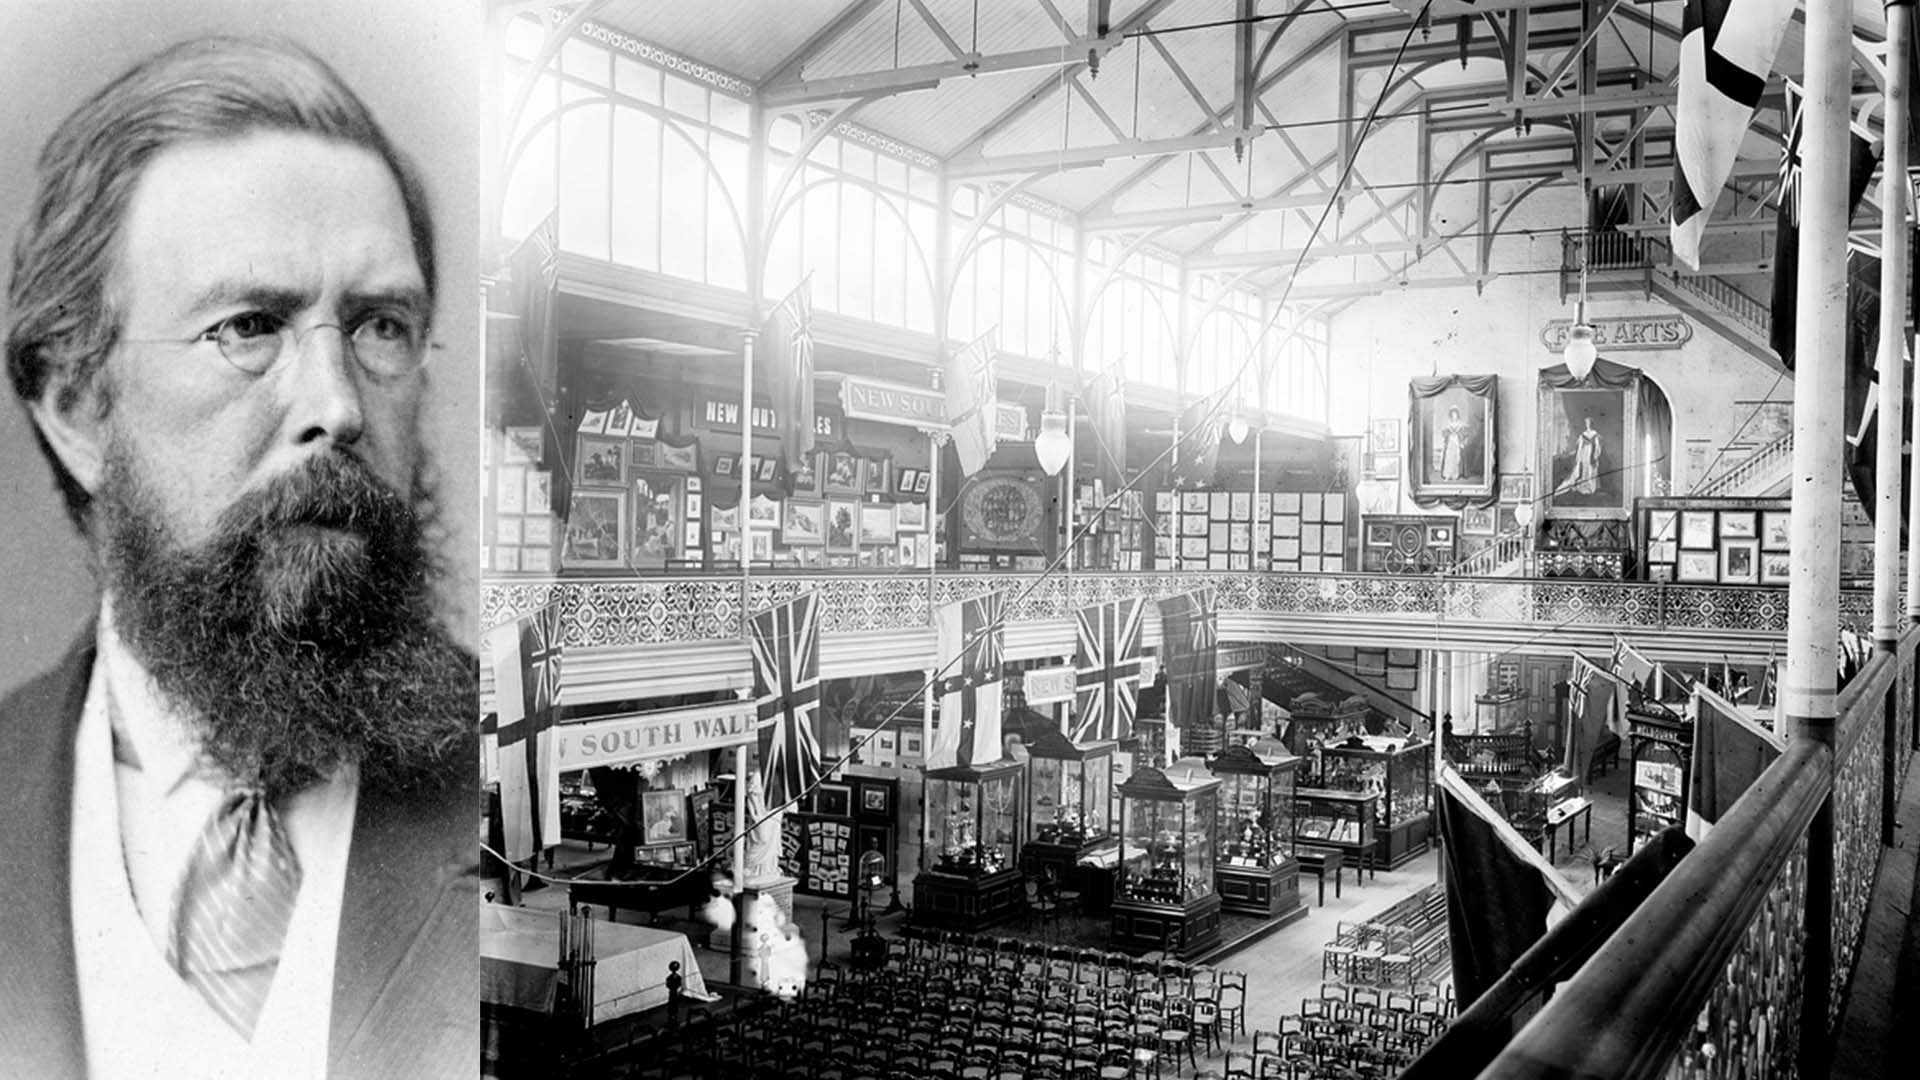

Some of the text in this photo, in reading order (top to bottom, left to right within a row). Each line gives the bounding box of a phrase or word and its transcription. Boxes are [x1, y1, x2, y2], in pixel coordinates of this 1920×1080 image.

[1553, 321, 1679, 346] FE ARTS
[853, 384, 896, 409] NEW
[706, 401, 738, 424] NEW
[581, 723, 682, 756] SOUTH
[694, 713, 757, 739] WALE
